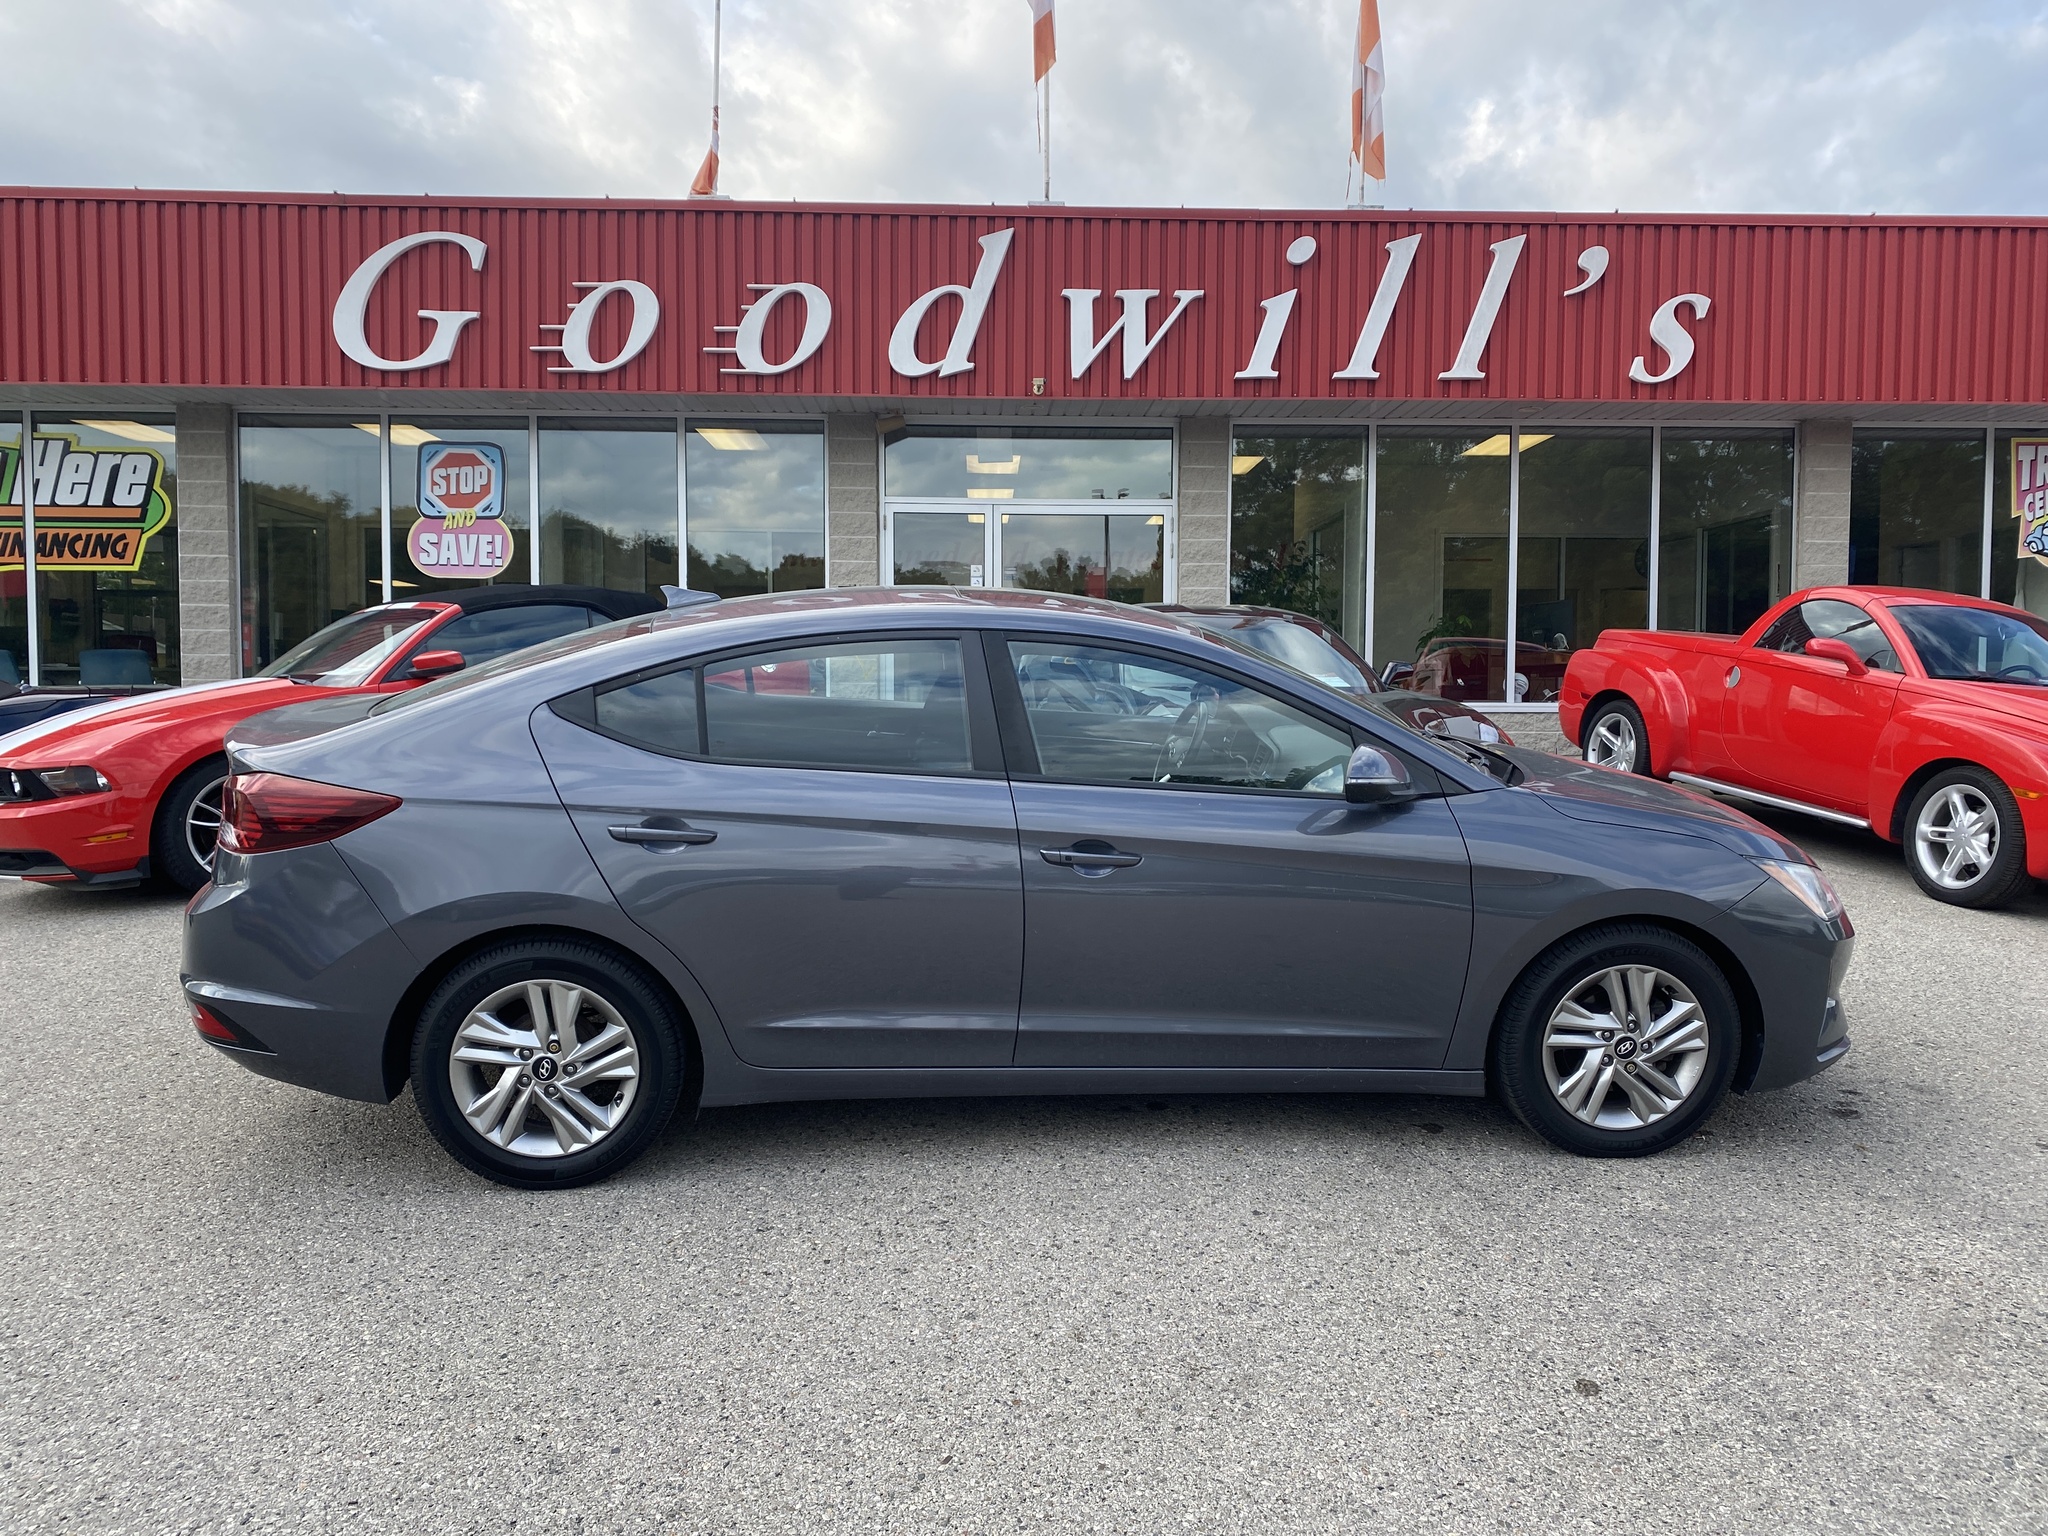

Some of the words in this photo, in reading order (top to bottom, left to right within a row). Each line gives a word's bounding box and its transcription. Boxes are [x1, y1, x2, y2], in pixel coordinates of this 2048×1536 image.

[332, 227, 1711, 385] Goodwill's
[11, 439, 152, 506] Here
[432, 465, 488, 496] STOP
[443, 508, 477, 531] AND
[2023, 490, 2048, 522] CE
[0, 531, 130, 560] INANCING
[418, 532, 504, 567] SAVE!
